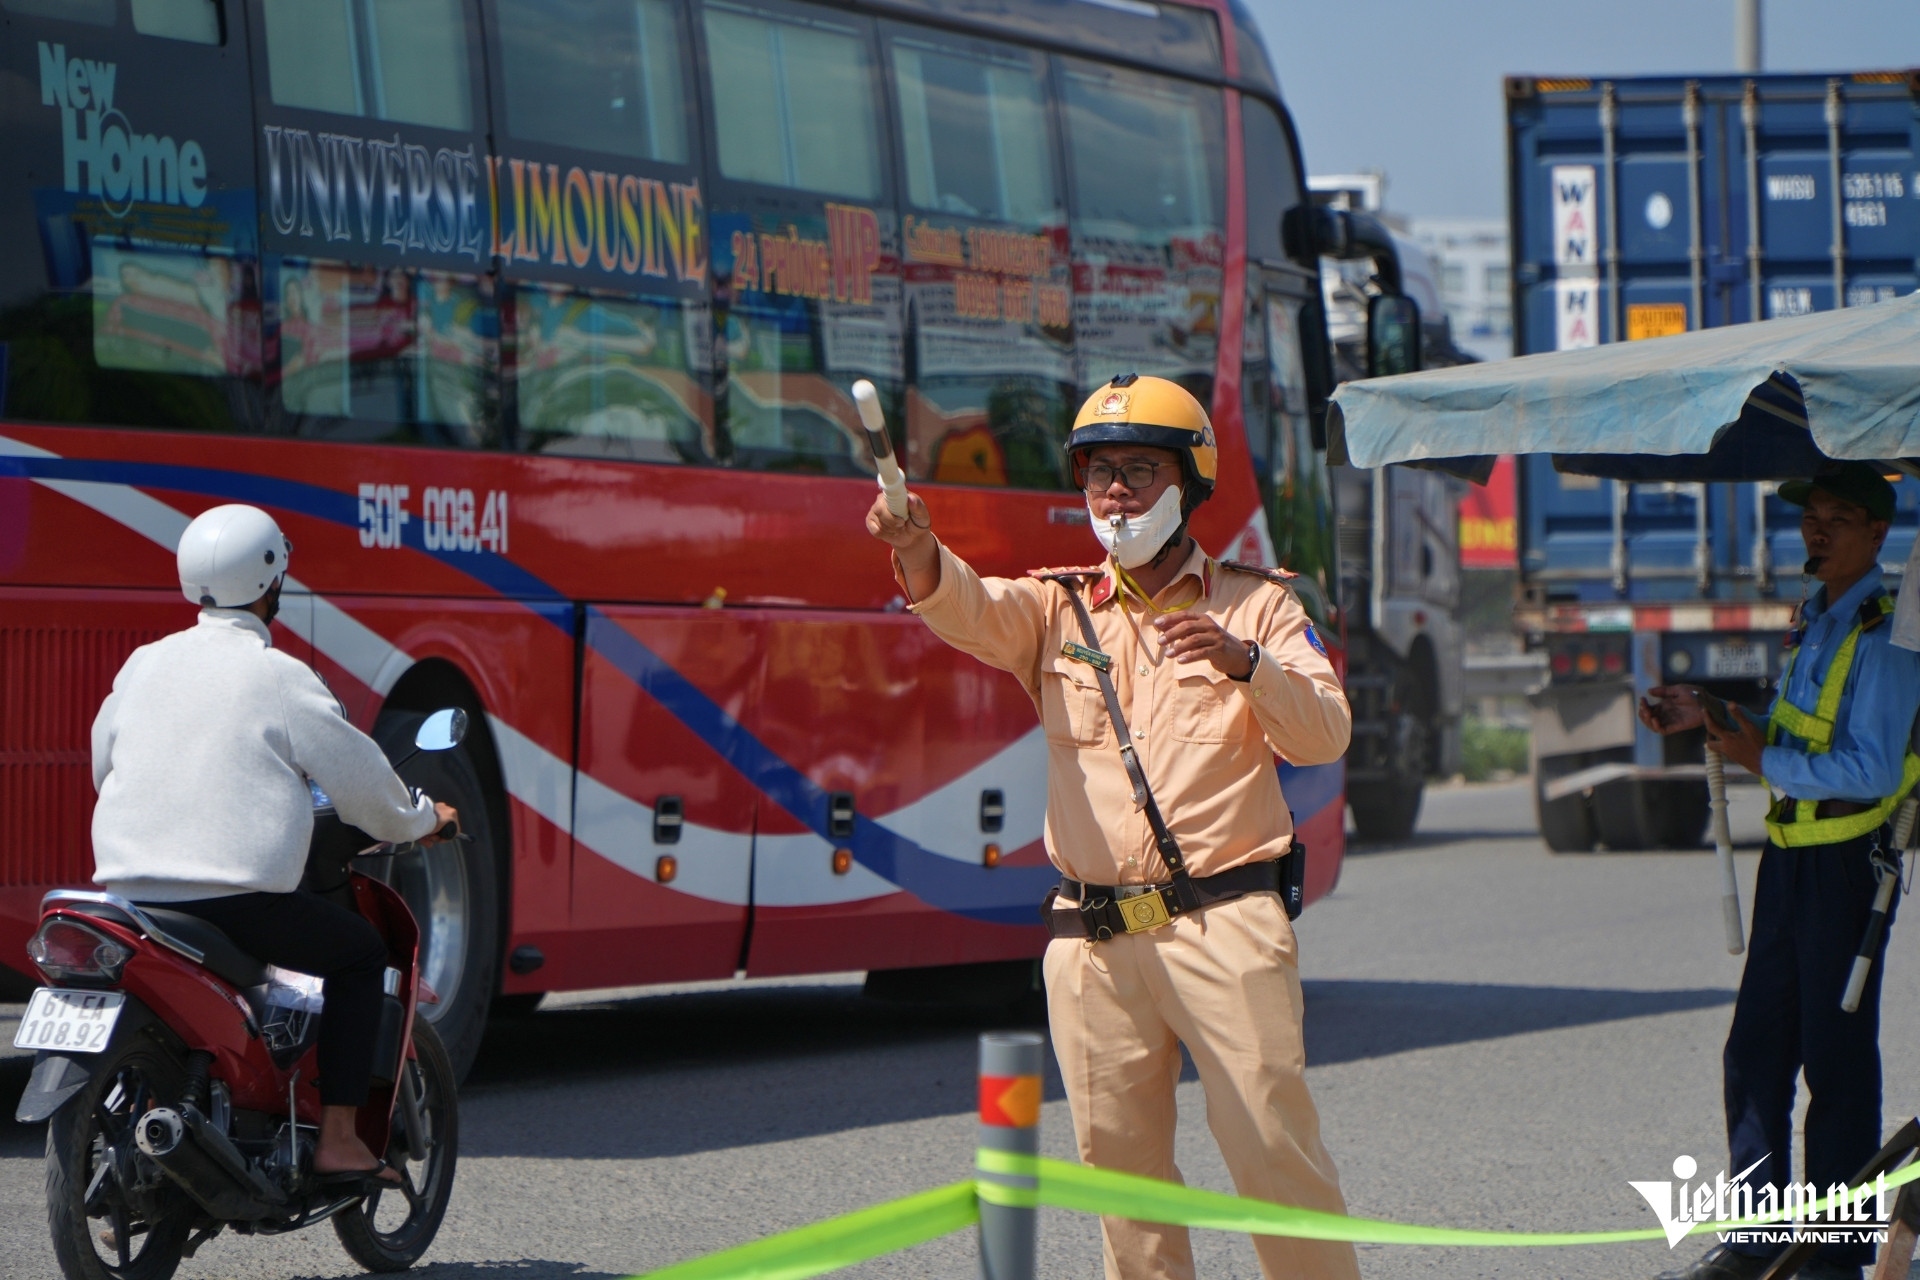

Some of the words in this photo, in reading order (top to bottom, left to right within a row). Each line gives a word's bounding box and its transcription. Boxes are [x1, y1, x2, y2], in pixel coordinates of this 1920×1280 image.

[37, 41, 117, 110] New
[61, 106, 207, 211] Home
[263, 125, 484, 264] UNIVERSE
[484, 154, 709, 291] LIMOUSINE
[1560, 183, 1592, 263] WAN
[731, 230, 759, 291] 24
[824, 202, 880, 306] VIP
[358, 482, 409, 549] 50F
[26, 1019, 107, 1048] 108.92
